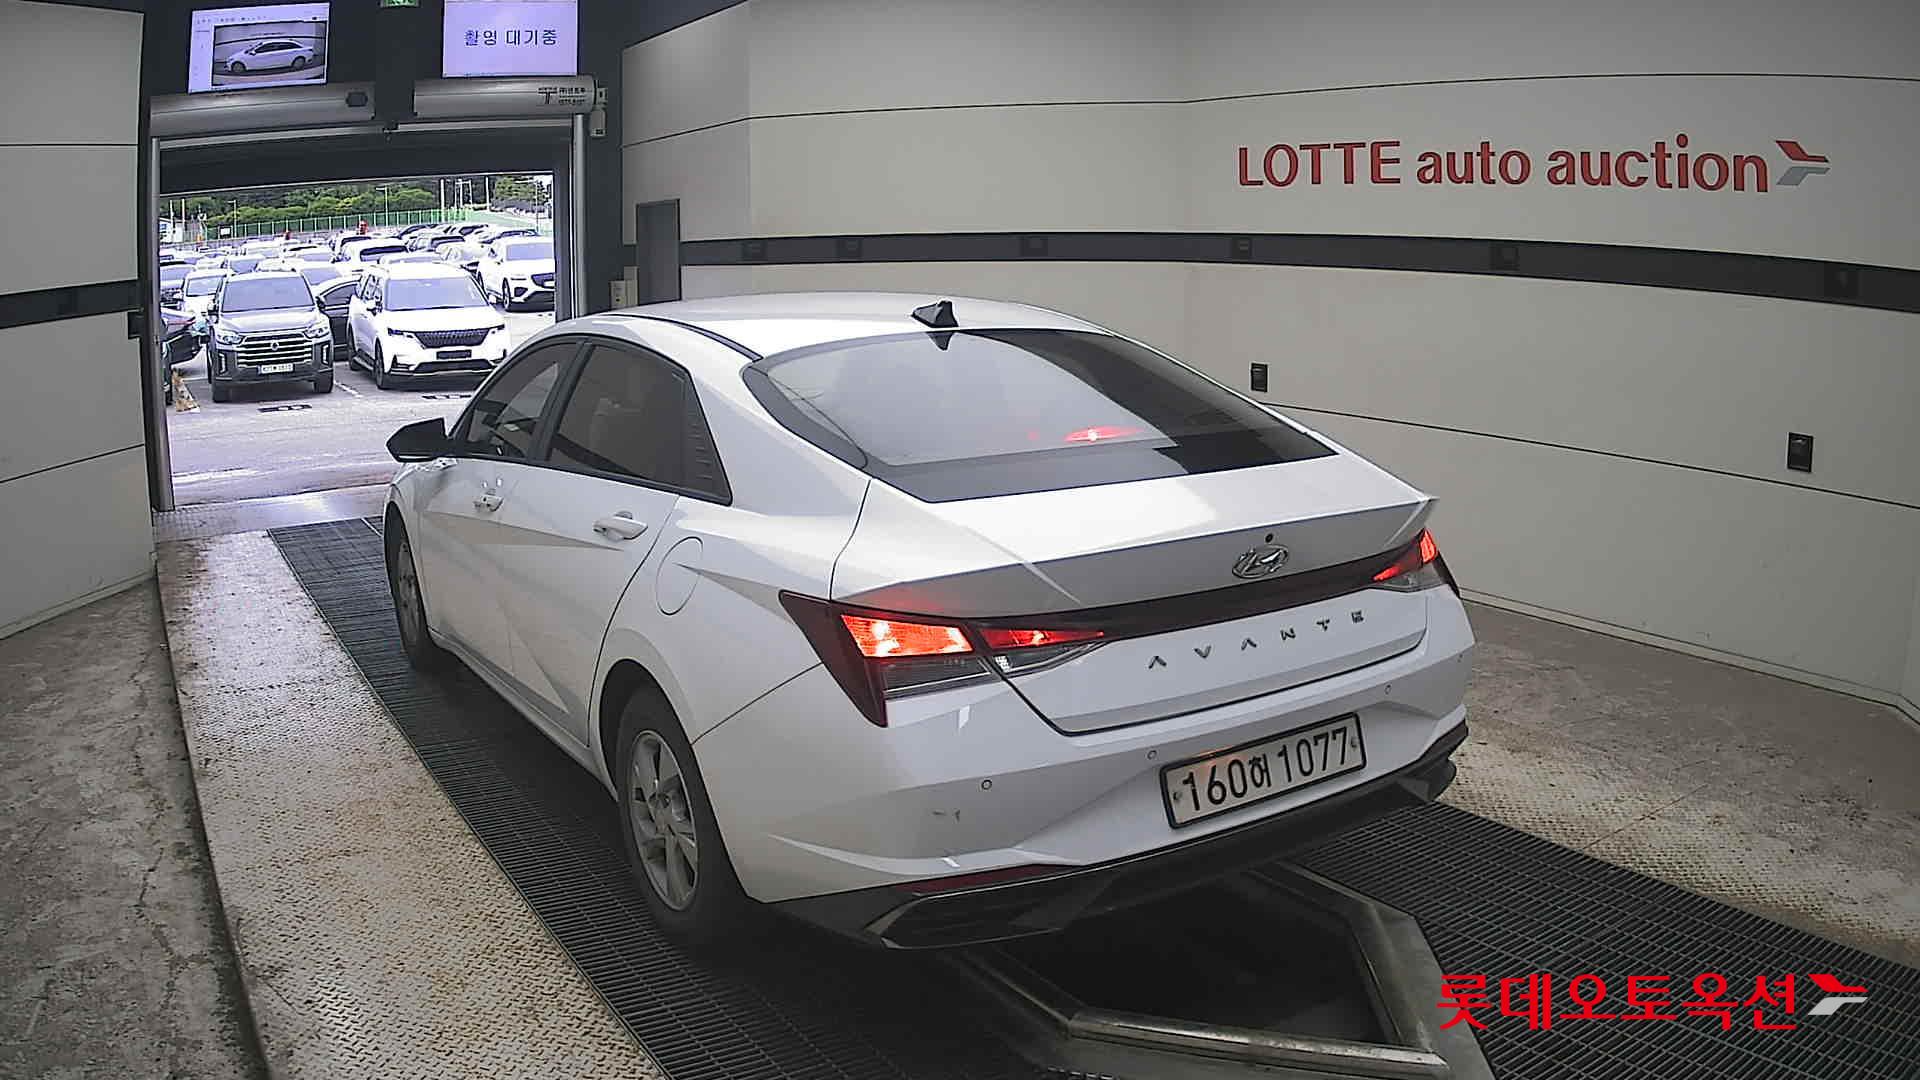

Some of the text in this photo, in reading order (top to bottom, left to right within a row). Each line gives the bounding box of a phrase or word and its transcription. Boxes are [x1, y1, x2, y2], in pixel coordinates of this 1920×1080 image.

[506, 29, 557, 46] 대기중
[1238, 133, 1768, 192] LOTTE auto auction
[1148, 610, 1363, 669] AVANTE
